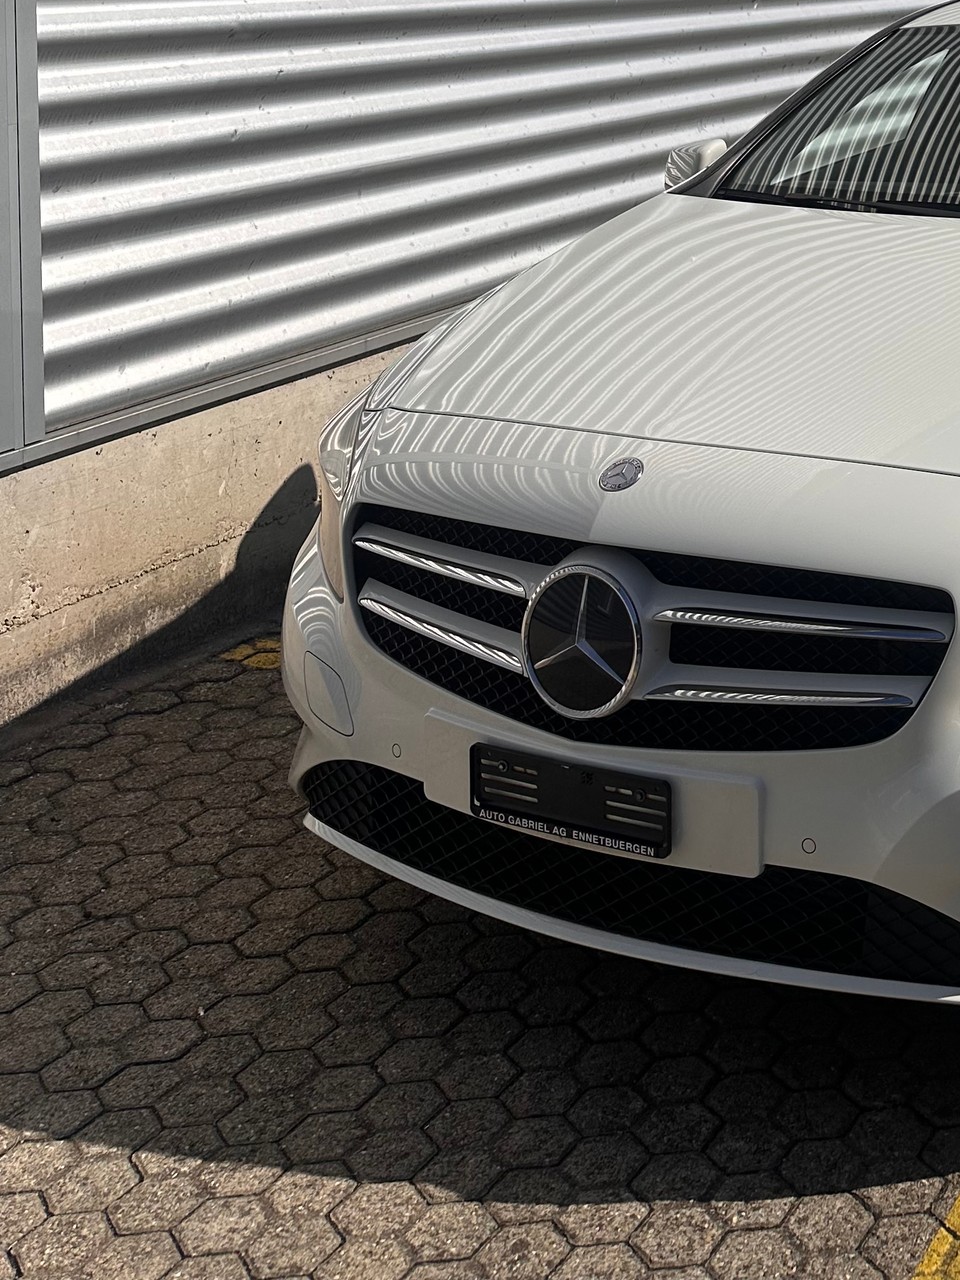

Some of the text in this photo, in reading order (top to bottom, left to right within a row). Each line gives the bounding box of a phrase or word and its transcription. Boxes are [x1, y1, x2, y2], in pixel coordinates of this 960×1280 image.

[479, 808, 656, 857] AUTO GABRIEL AG ENNETBUERGEN
